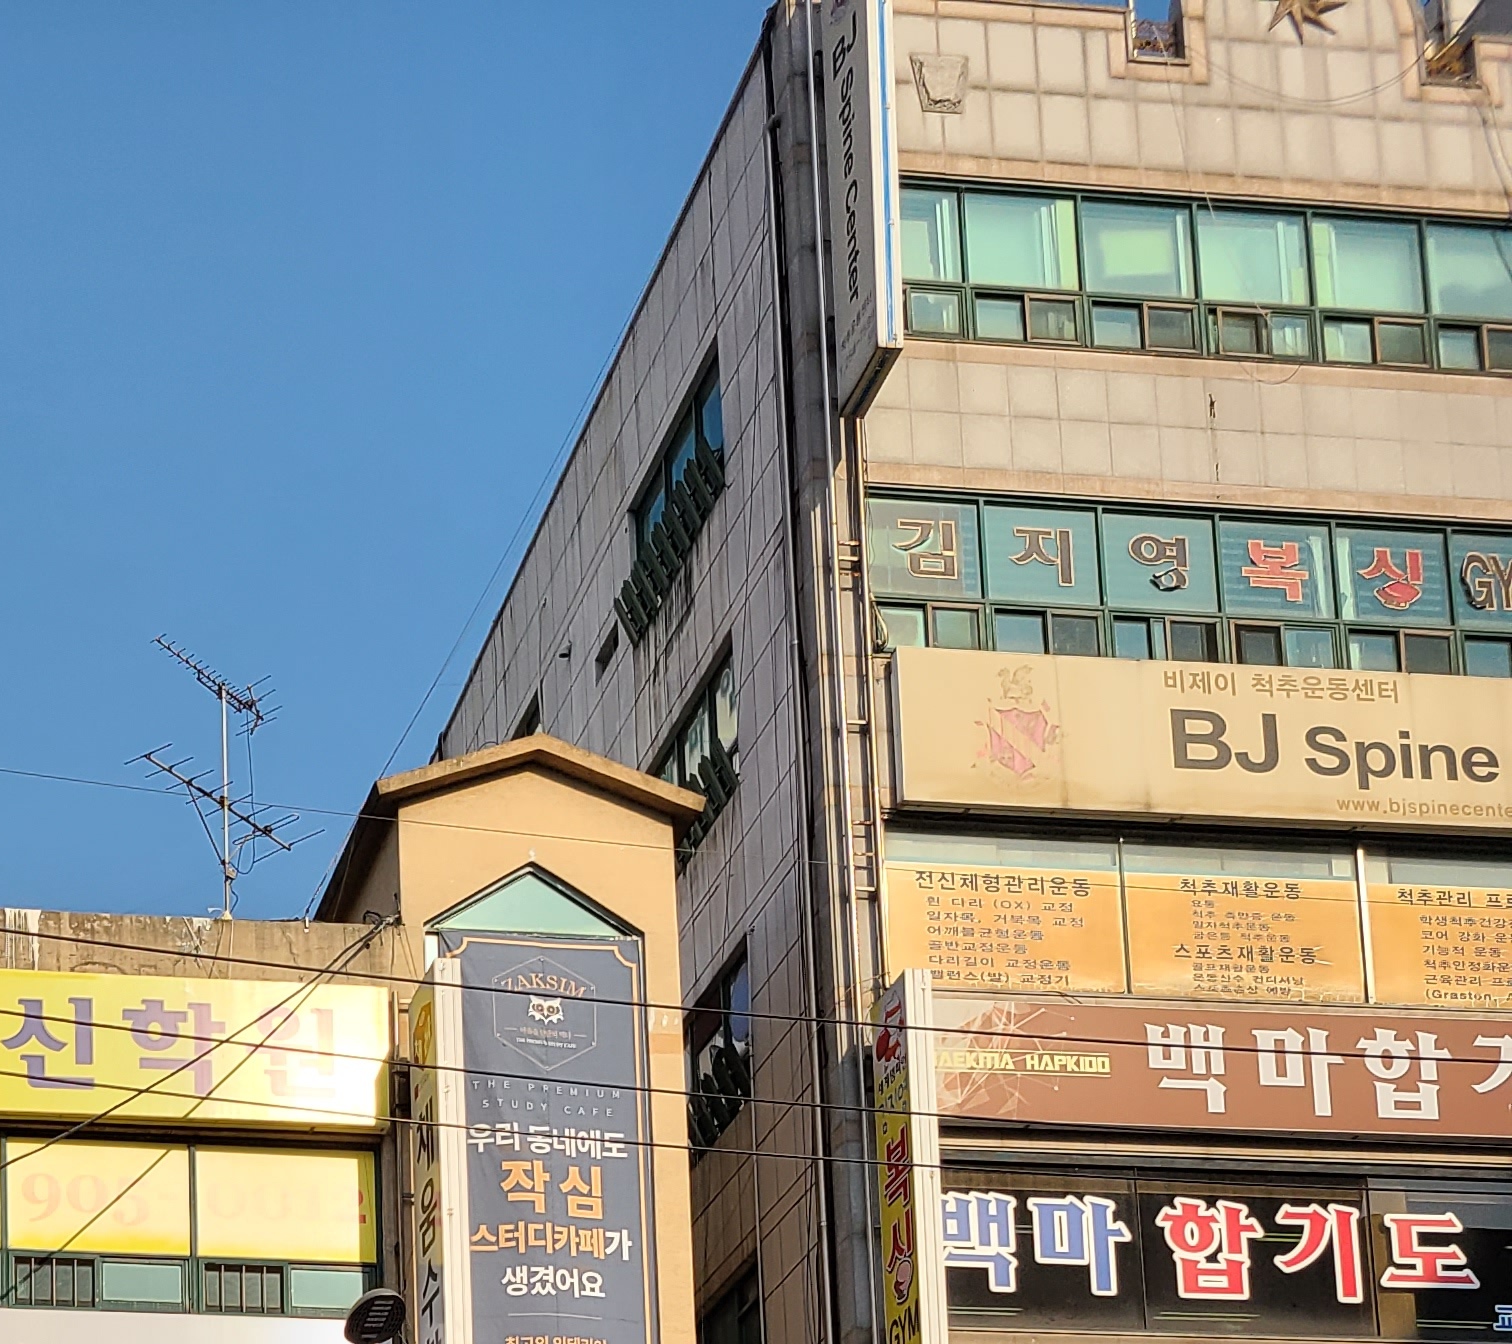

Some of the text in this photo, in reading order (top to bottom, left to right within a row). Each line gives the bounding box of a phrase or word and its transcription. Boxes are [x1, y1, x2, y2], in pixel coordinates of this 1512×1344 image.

[892, 518, 1425, 610] 김지영 복싱
[1163, 668, 1400, 704] 비제이 척추운동센터
[1169, 707, 1500, 791] BJ Spine
[915, 870, 1091, 897] 전신체형관리운동
[1180, 878, 1302, 900] 척추재활운동
[1041, 902, 1074, 913] 교정
[1397, 888, 1472, 908] 척추관리
[1052, 917, 1085, 928] 교정
[1421, 931, 1486, 943] 코어 강화
[1174, 944, 1317, 965] 스포츠재활운동
[1025, 1054, 1111, 1073] HAPKIDO
[473, 1079, 621, 1100] THE PREMIUM
[482, 1098, 614, 1118] STUDY CAFE
[467, 1123, 628, 1159] 우리 동네에도
[500, 1159, 604, 1219] 작심
[469, 1220, 633, 1261] 스터디카페가
[501, 1265, 606, 1298] 생겼어요
